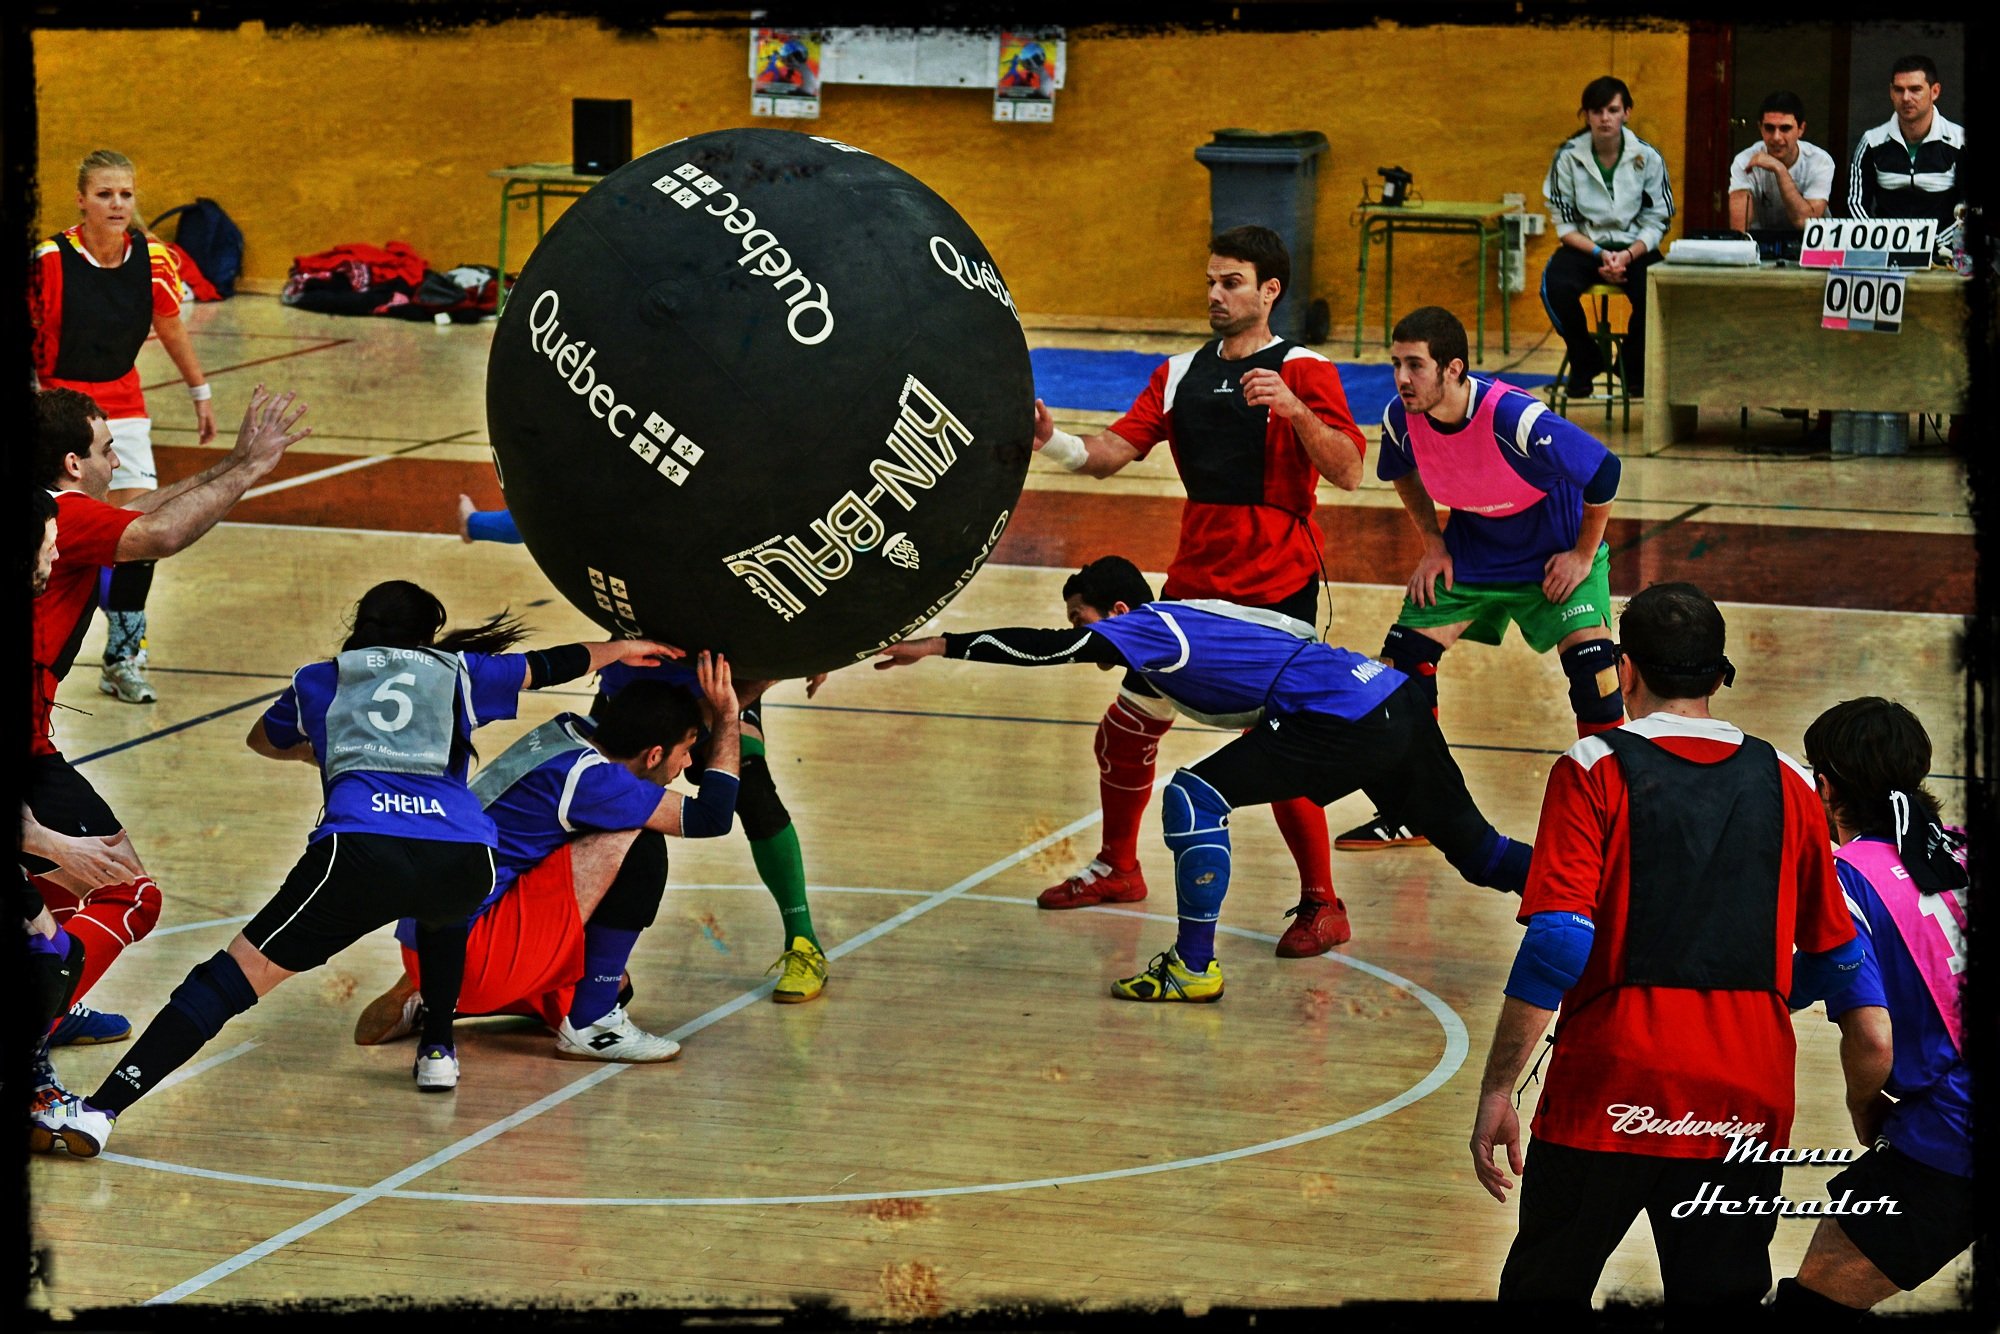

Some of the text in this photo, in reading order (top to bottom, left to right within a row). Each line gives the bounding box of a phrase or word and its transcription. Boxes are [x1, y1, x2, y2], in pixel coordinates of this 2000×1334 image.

[705, 192, 835, 346] Québec
[528, 289, 637, 439] Québec
[744, 575, 795, 623] sport
[366, 649, 435, 668] ESPAGNE
[367, 672, 416, 733] 5
[371, 792, 447, 817] SHEILA
